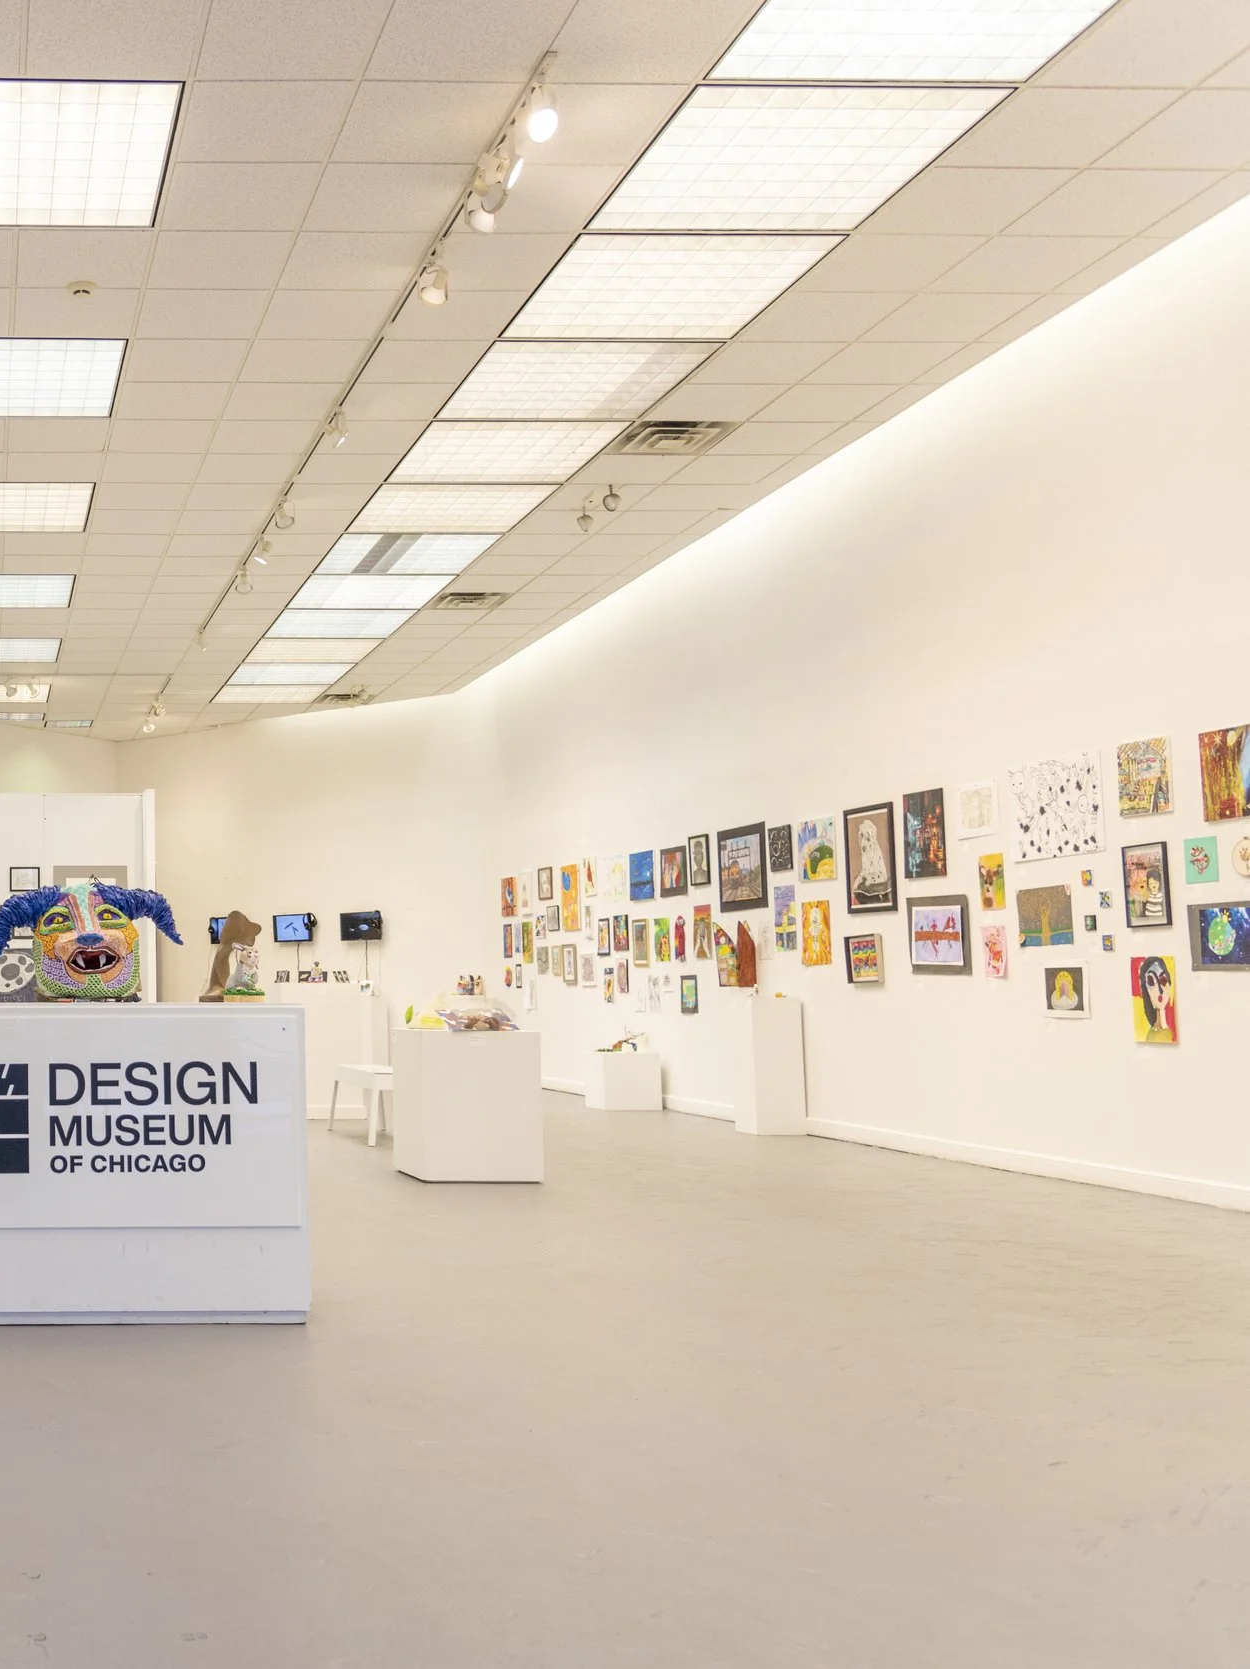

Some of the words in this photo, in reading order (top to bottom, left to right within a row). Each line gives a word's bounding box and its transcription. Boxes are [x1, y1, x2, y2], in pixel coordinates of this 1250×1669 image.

[48, 1061, 258, 1106] DESIGN
[49, 1114, 232, 1146] MUSEUM
[49, 1155, 83, 1173] OF
[90, 1154, 206, 1173] CHICAGO
